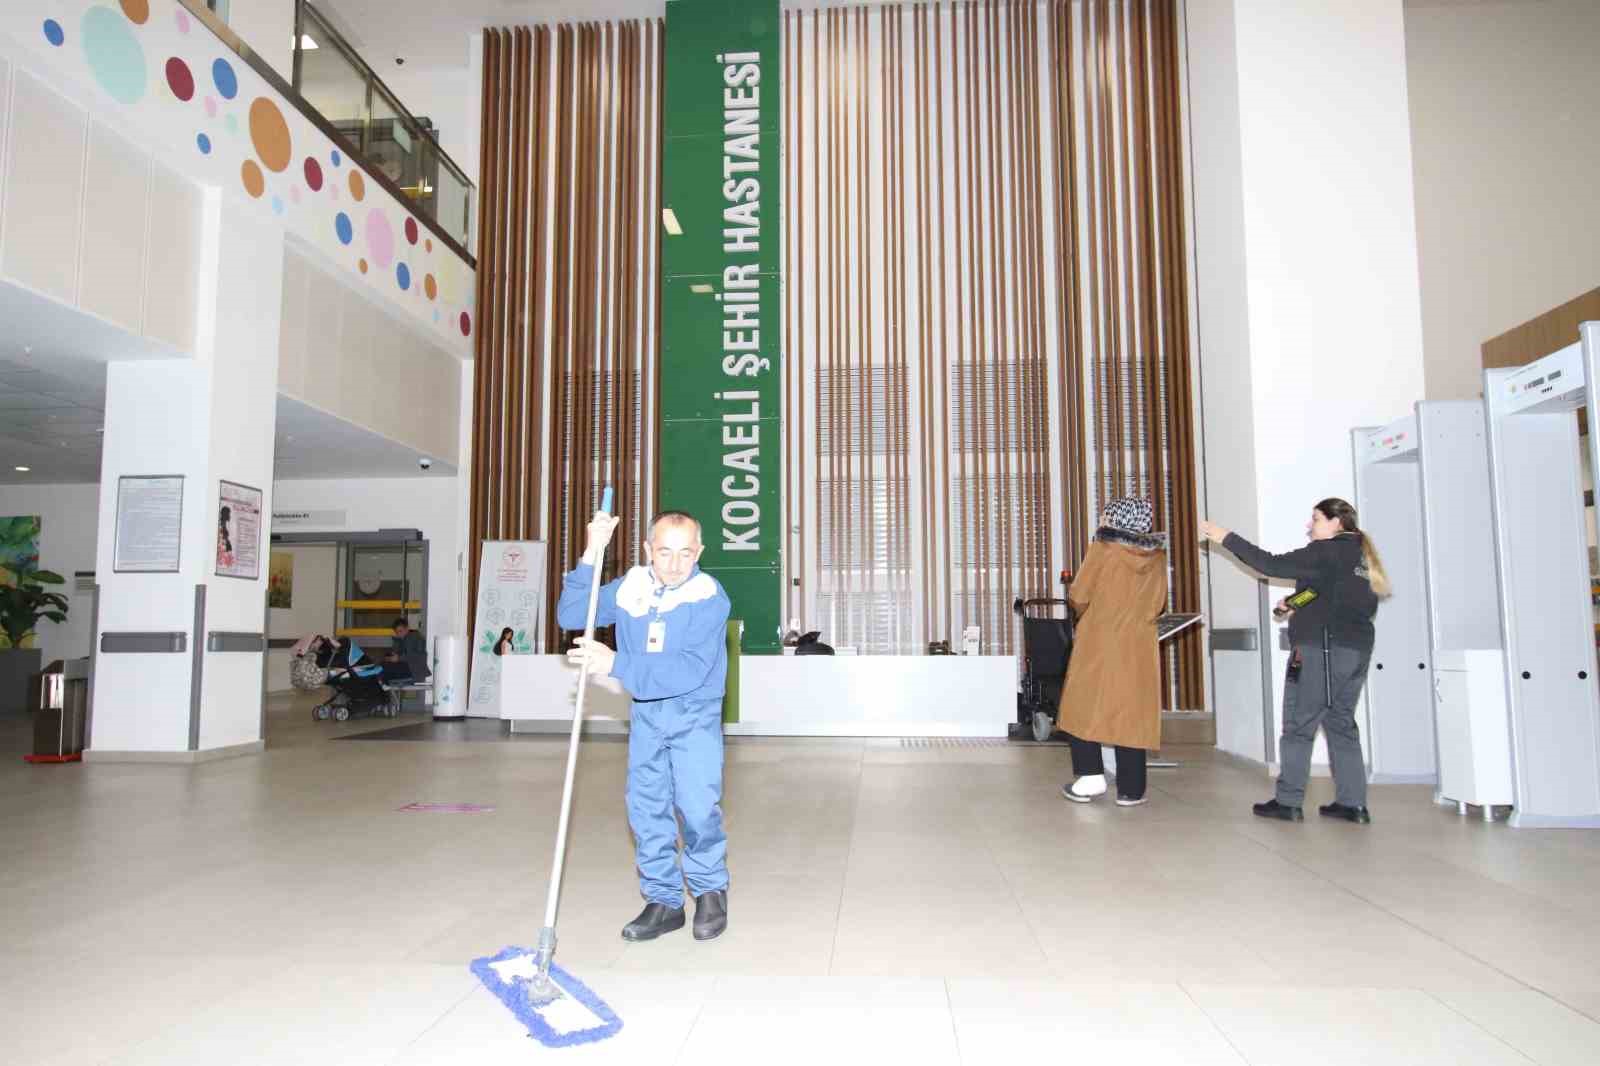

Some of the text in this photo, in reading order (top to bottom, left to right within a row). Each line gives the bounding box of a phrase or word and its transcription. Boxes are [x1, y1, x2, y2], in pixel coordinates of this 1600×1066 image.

[714, 52, 770, 550] KOCAELİ ŞEHİR HASTANESİ
